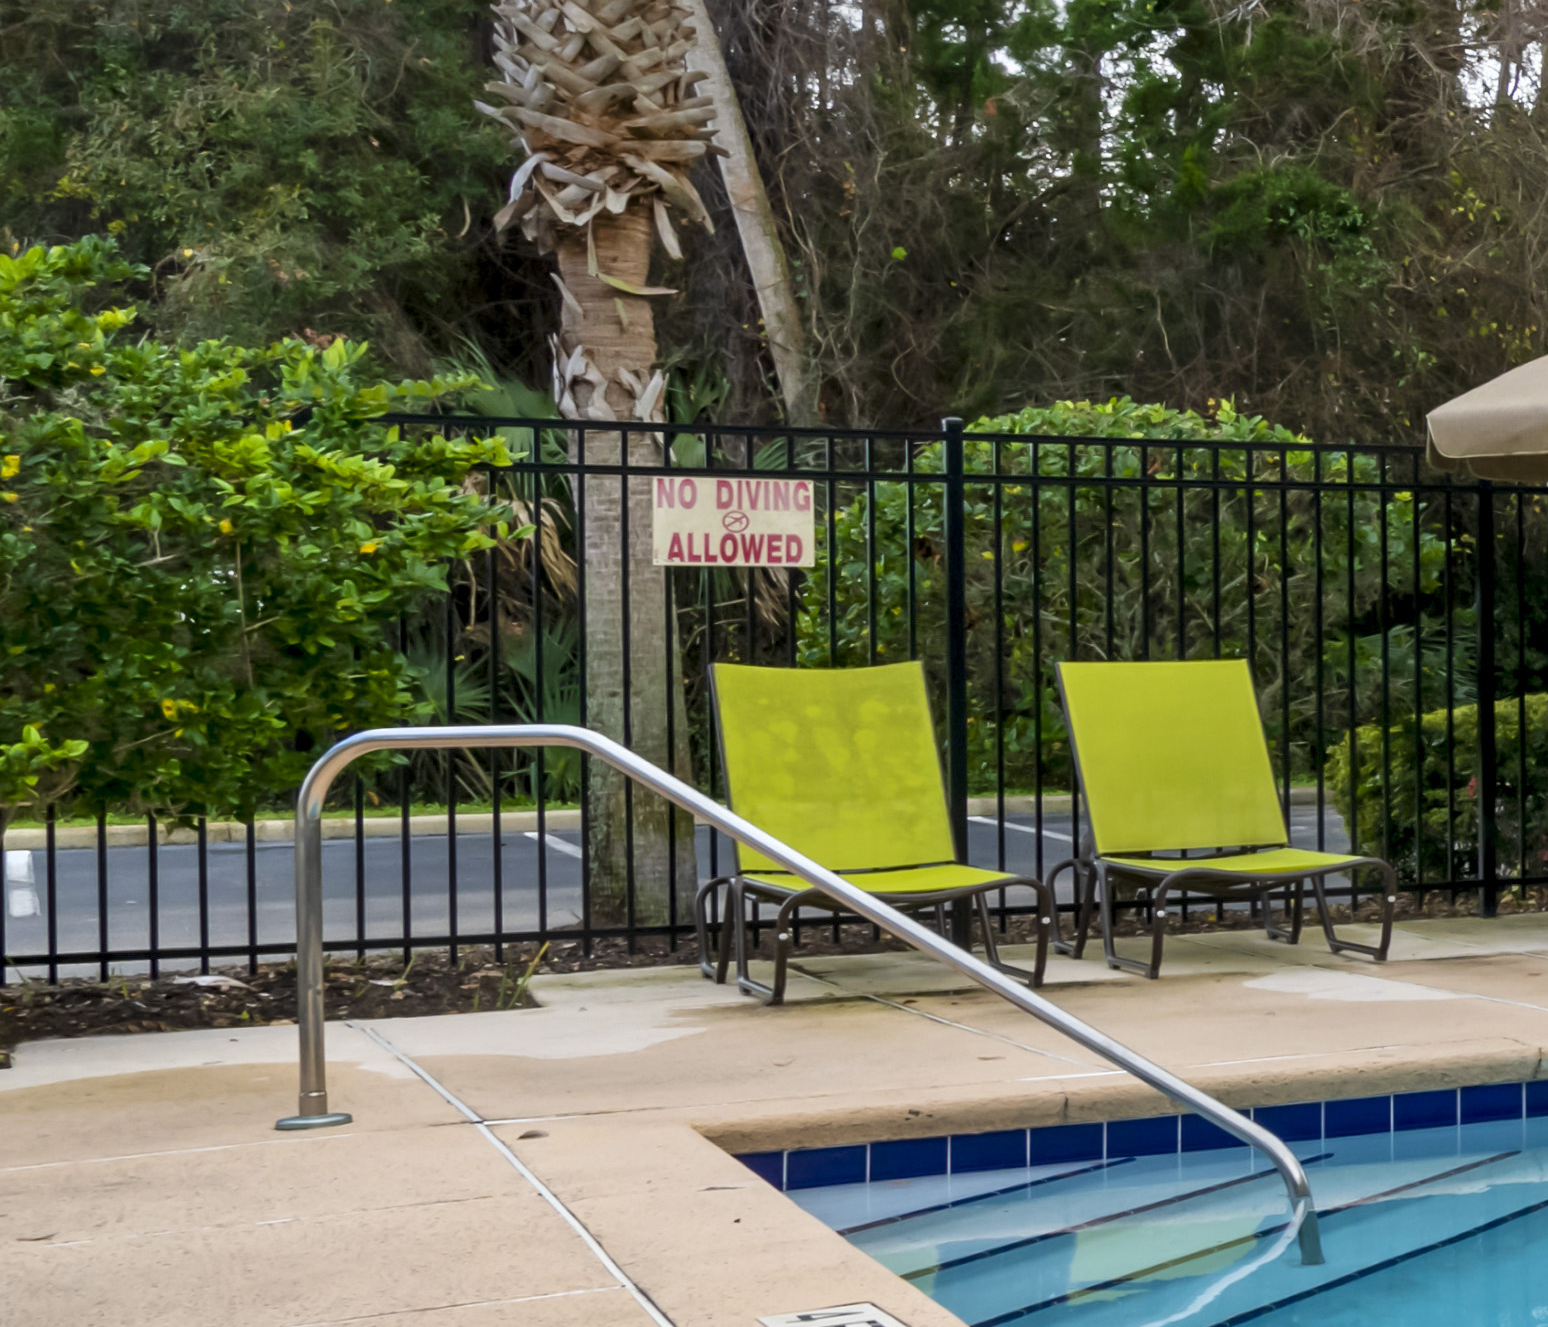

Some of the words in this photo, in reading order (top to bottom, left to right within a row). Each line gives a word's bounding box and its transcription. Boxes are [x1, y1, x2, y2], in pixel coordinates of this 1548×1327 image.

[656, 478, 697, 509] NO
[716, 480, 811, 511] DIVING
[667, 532, 804, 563] ALLOWED
